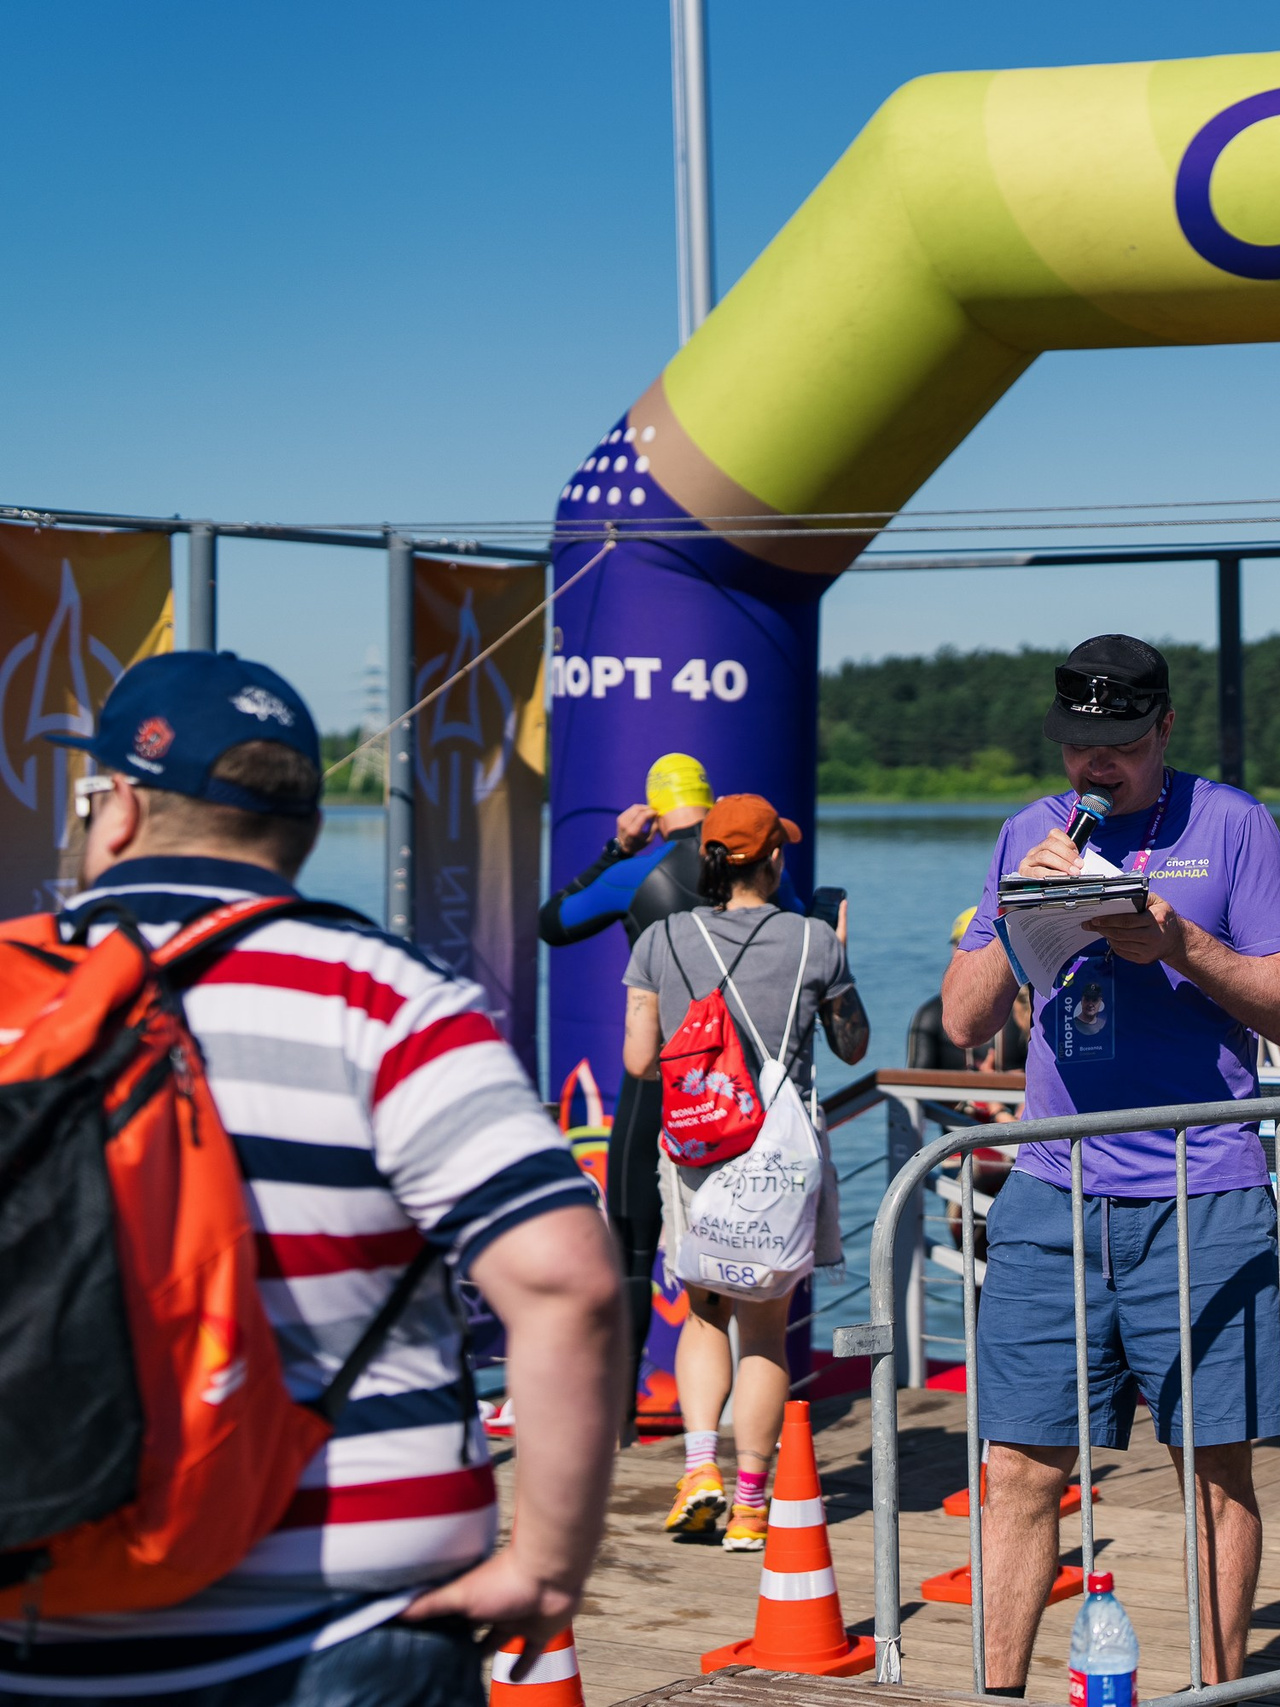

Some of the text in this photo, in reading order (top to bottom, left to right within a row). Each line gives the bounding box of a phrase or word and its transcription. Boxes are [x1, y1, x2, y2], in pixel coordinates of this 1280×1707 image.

[672, 658, 748, 702] 40
[1149, 868, 1208, 879] КОМАНДА
[1064, 996, 1073, 1057] СПОРТ 40
[701, 1215, 771, 1235] КАМЕРА
[690, 1225, 785, 1250] ХРАНЕНИЯ
[717, 1262, 757, 1286] 168
